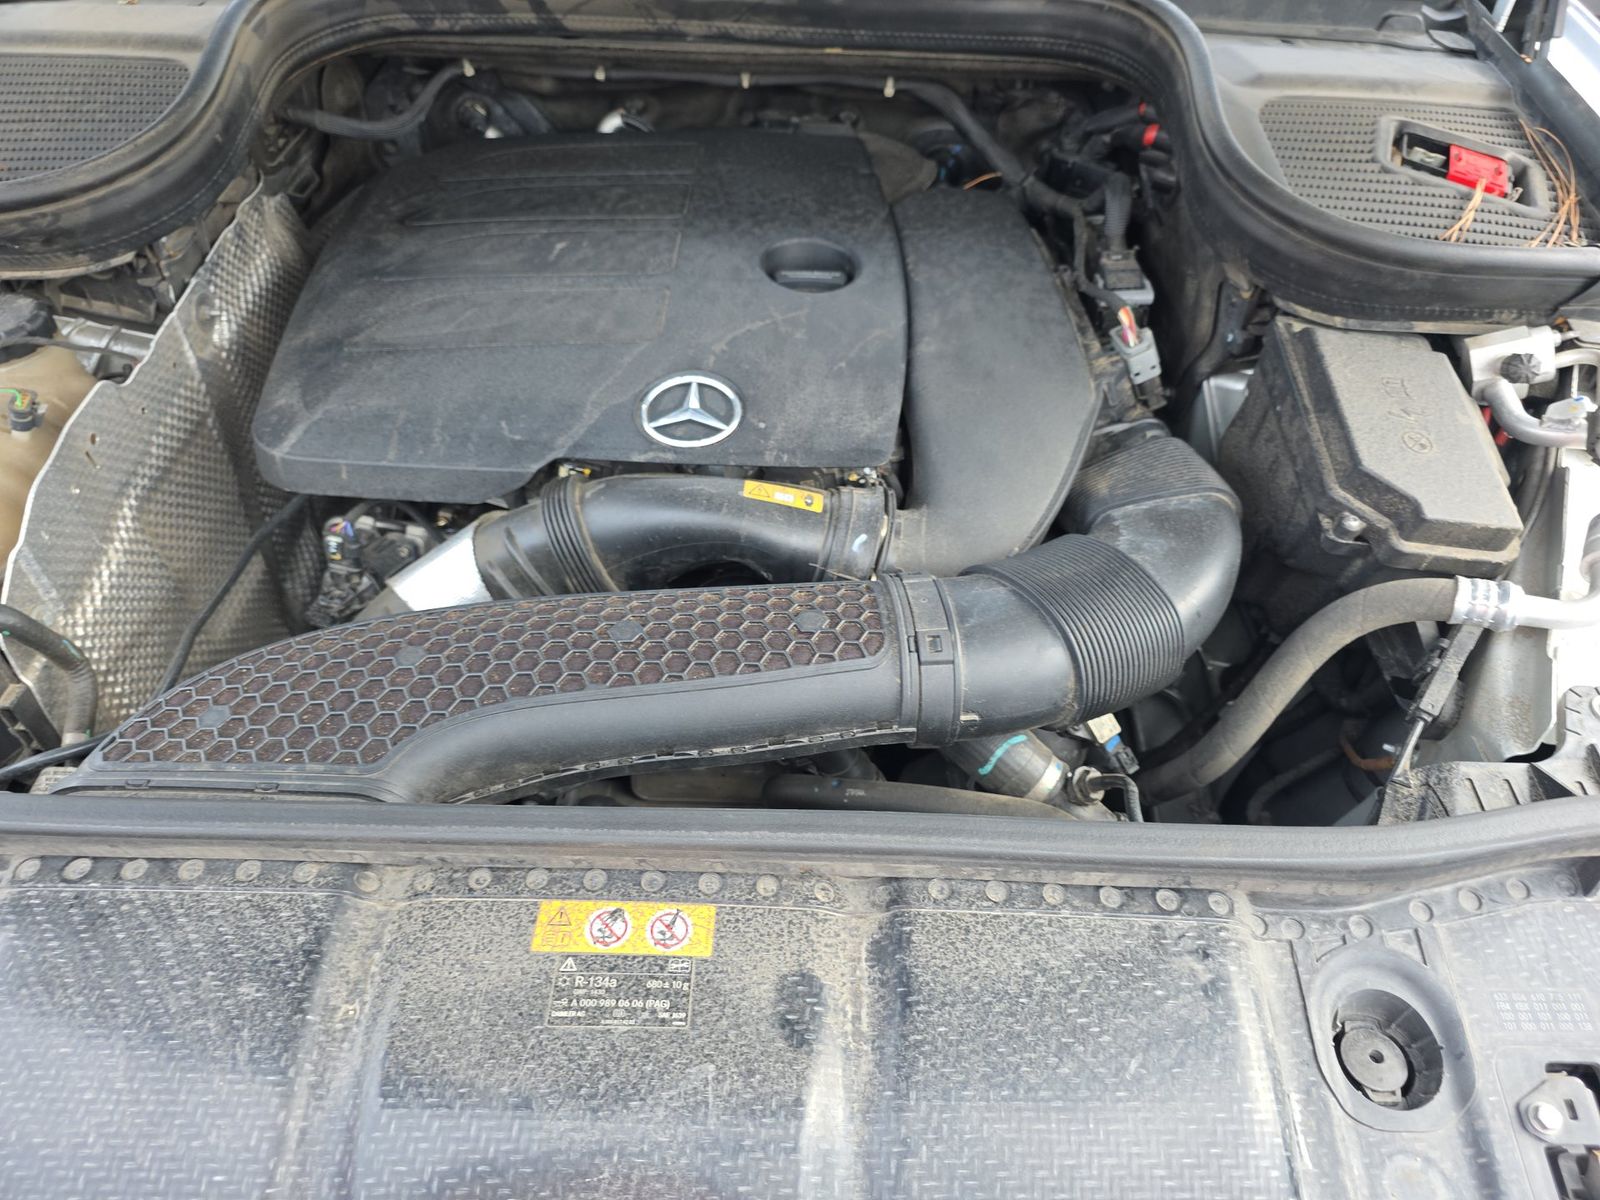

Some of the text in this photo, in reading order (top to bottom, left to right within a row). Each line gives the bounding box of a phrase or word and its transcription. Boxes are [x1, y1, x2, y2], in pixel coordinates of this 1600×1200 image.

[574, 975, 618, 988] R-134a
[672, 980, 682, 989] 10
[570, 998, 671, 1010] A 000 989 06 06 (PAG)
